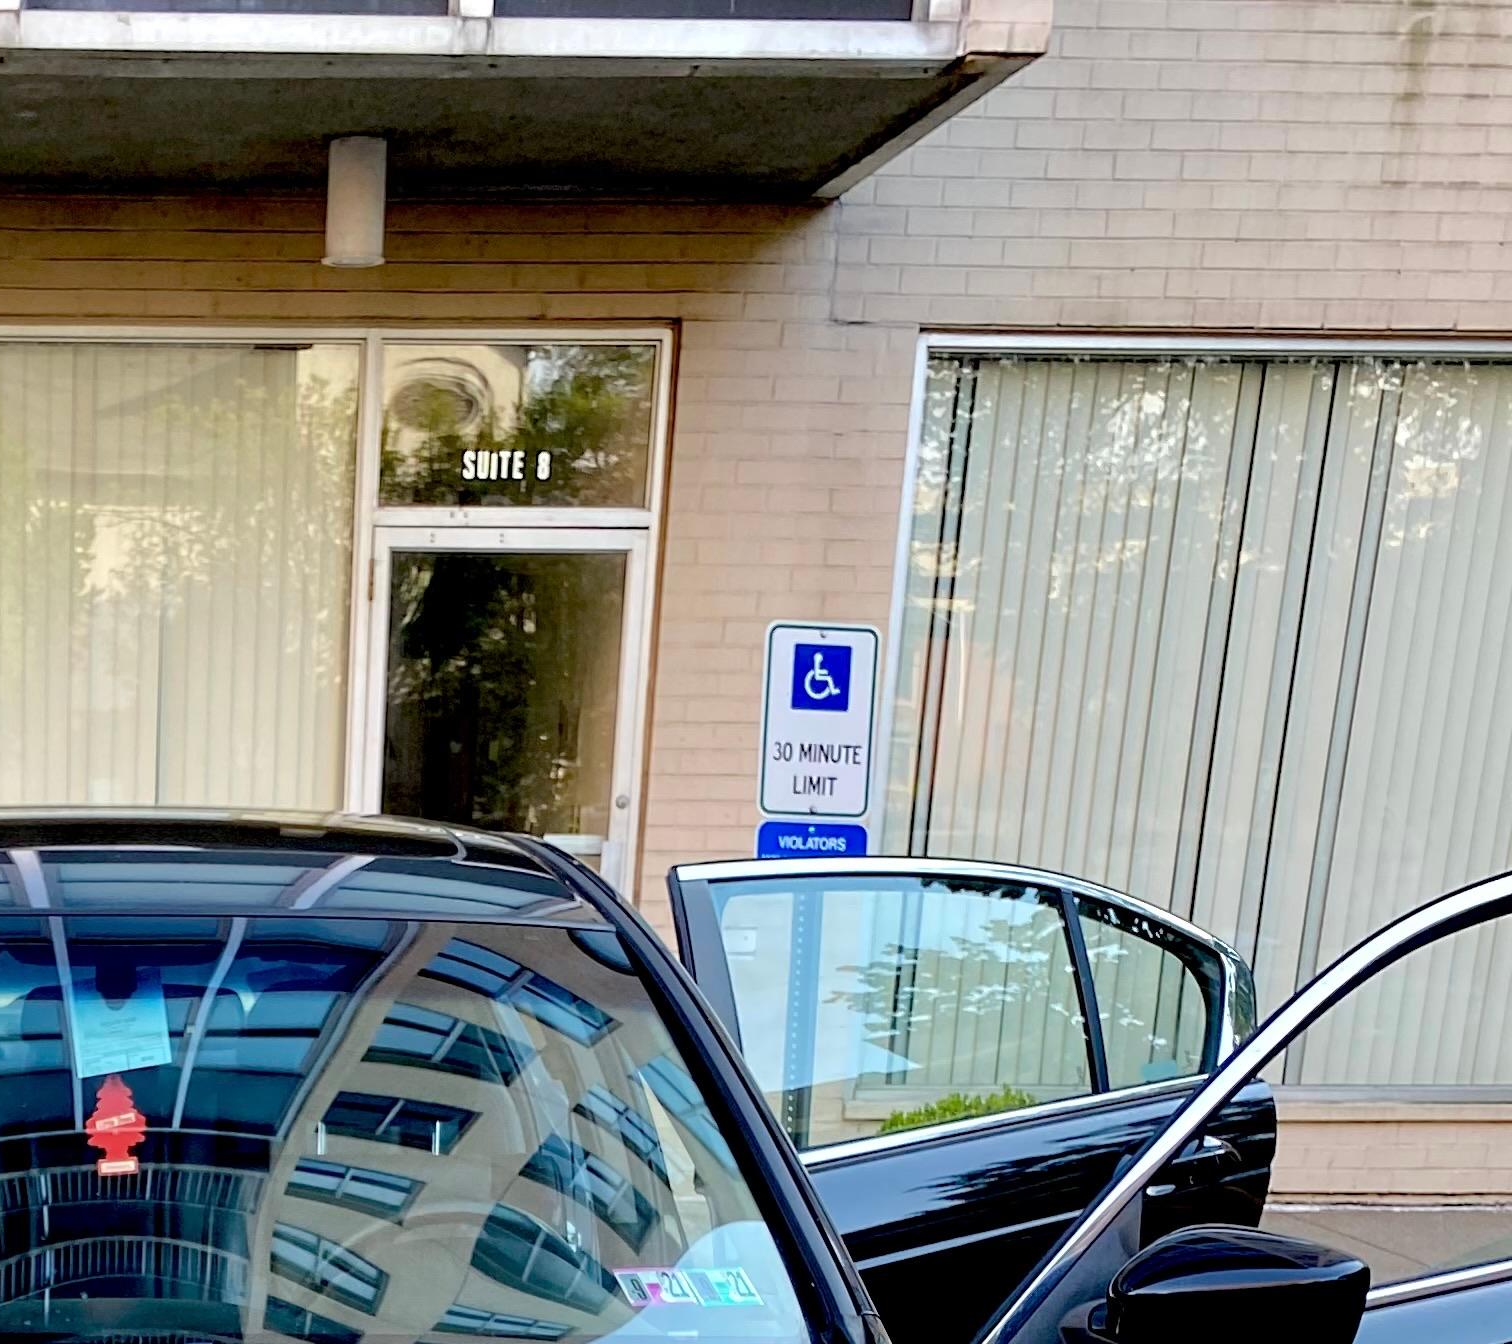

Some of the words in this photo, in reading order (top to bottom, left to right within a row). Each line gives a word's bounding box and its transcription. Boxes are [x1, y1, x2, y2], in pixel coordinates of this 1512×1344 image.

[462, 450, 524, 480] SUITE
[537, 451, 551, 480] 8
[773, 742, 792, 762] 30
[799, 743, 862, 764] MINUTE
[793, 775, 837, 796] LIMIT
[778, 836, 847, 852] VIOLATORS
